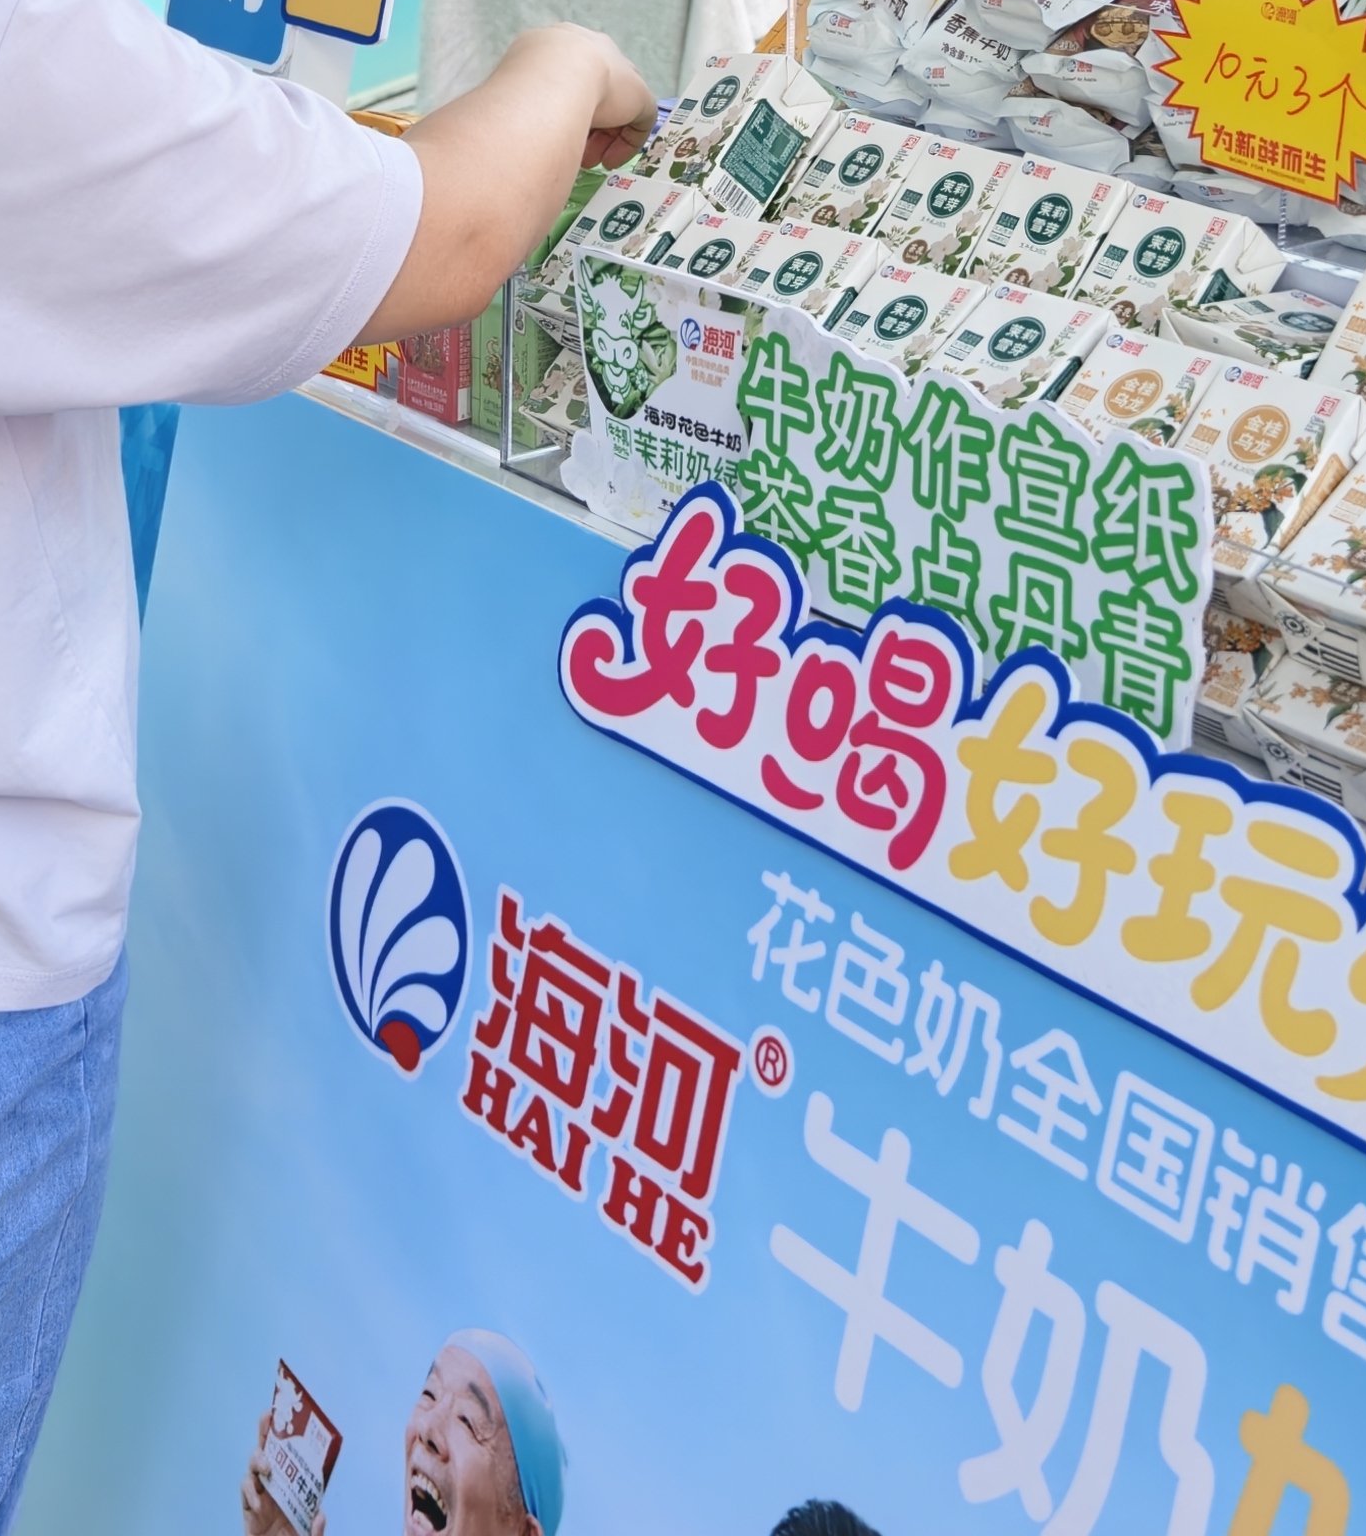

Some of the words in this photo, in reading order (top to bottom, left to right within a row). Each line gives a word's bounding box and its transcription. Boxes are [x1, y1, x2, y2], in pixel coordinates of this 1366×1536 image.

[1212, 122, 1327, 182] 为新鲜而生
[1147, 233, 1183, 255] 茉莉
[702, 324, 736, 351] 海河
[1109, 392, 1146, 412] 乌龙
[1123, 376, 1157, 398] 金桂
[643, 404, 742, 454] 海河花色牛奶
[1233, 432, 1272, 457] 乌龙
[1244, 415, 1284, 439] 金桂
[633, 427, 739, 492] 茉莉奶绿
[739, 334, 1197, 604] 牛奶作宣纸
[741, 450, 1195, 739] 茶香点丹青
[476, 892, 742, 1200] 海河
[461, 1049, 592, 1193] HAI
[602, 1153, 712, 1286] HE
